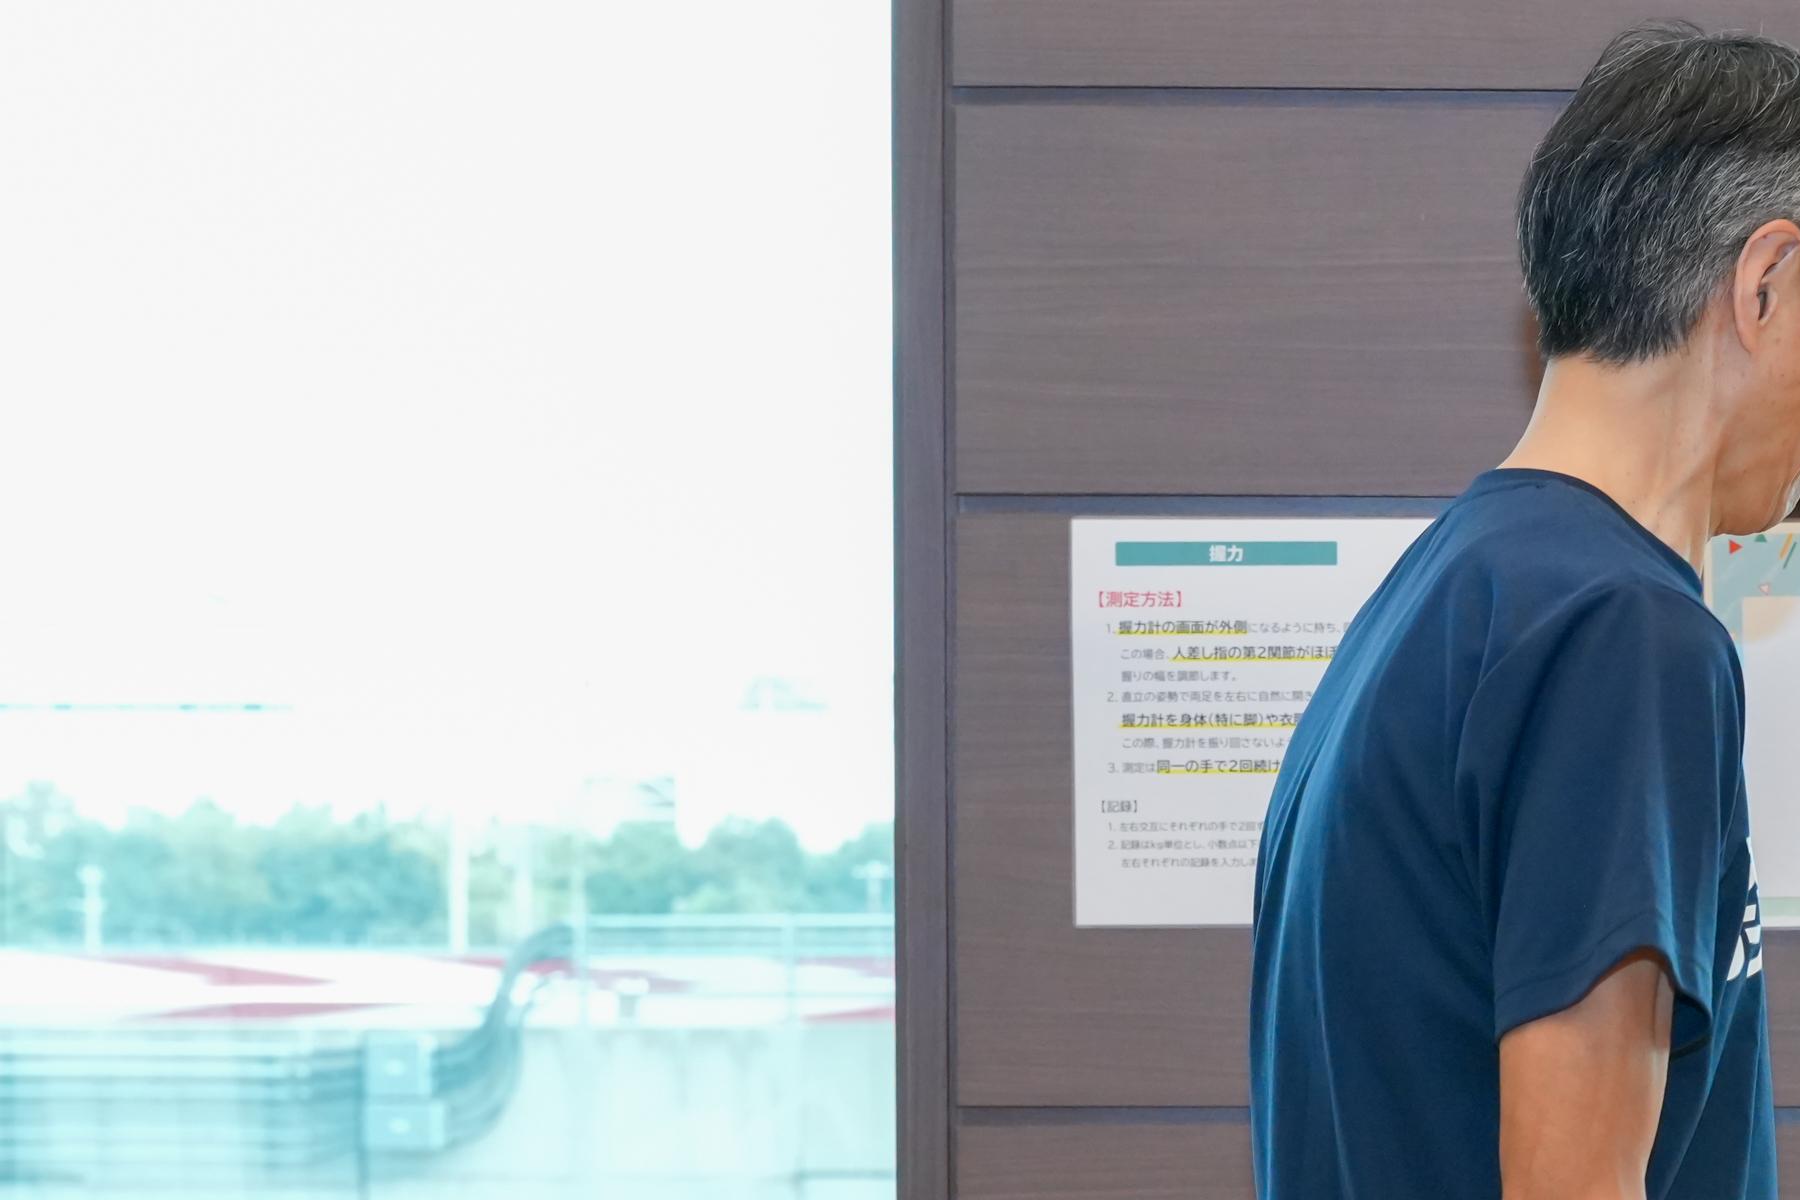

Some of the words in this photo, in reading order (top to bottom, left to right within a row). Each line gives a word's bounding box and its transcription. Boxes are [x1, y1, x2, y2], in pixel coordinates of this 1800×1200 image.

[1208, 545, 1244, 563] 握力
[1097, 591, 1184, 608] 【測定方法】
[1121, 737, 1291, 750] この際、握力計を振り回さないよ
[1100, 800, 1138, 814] 【記録】
